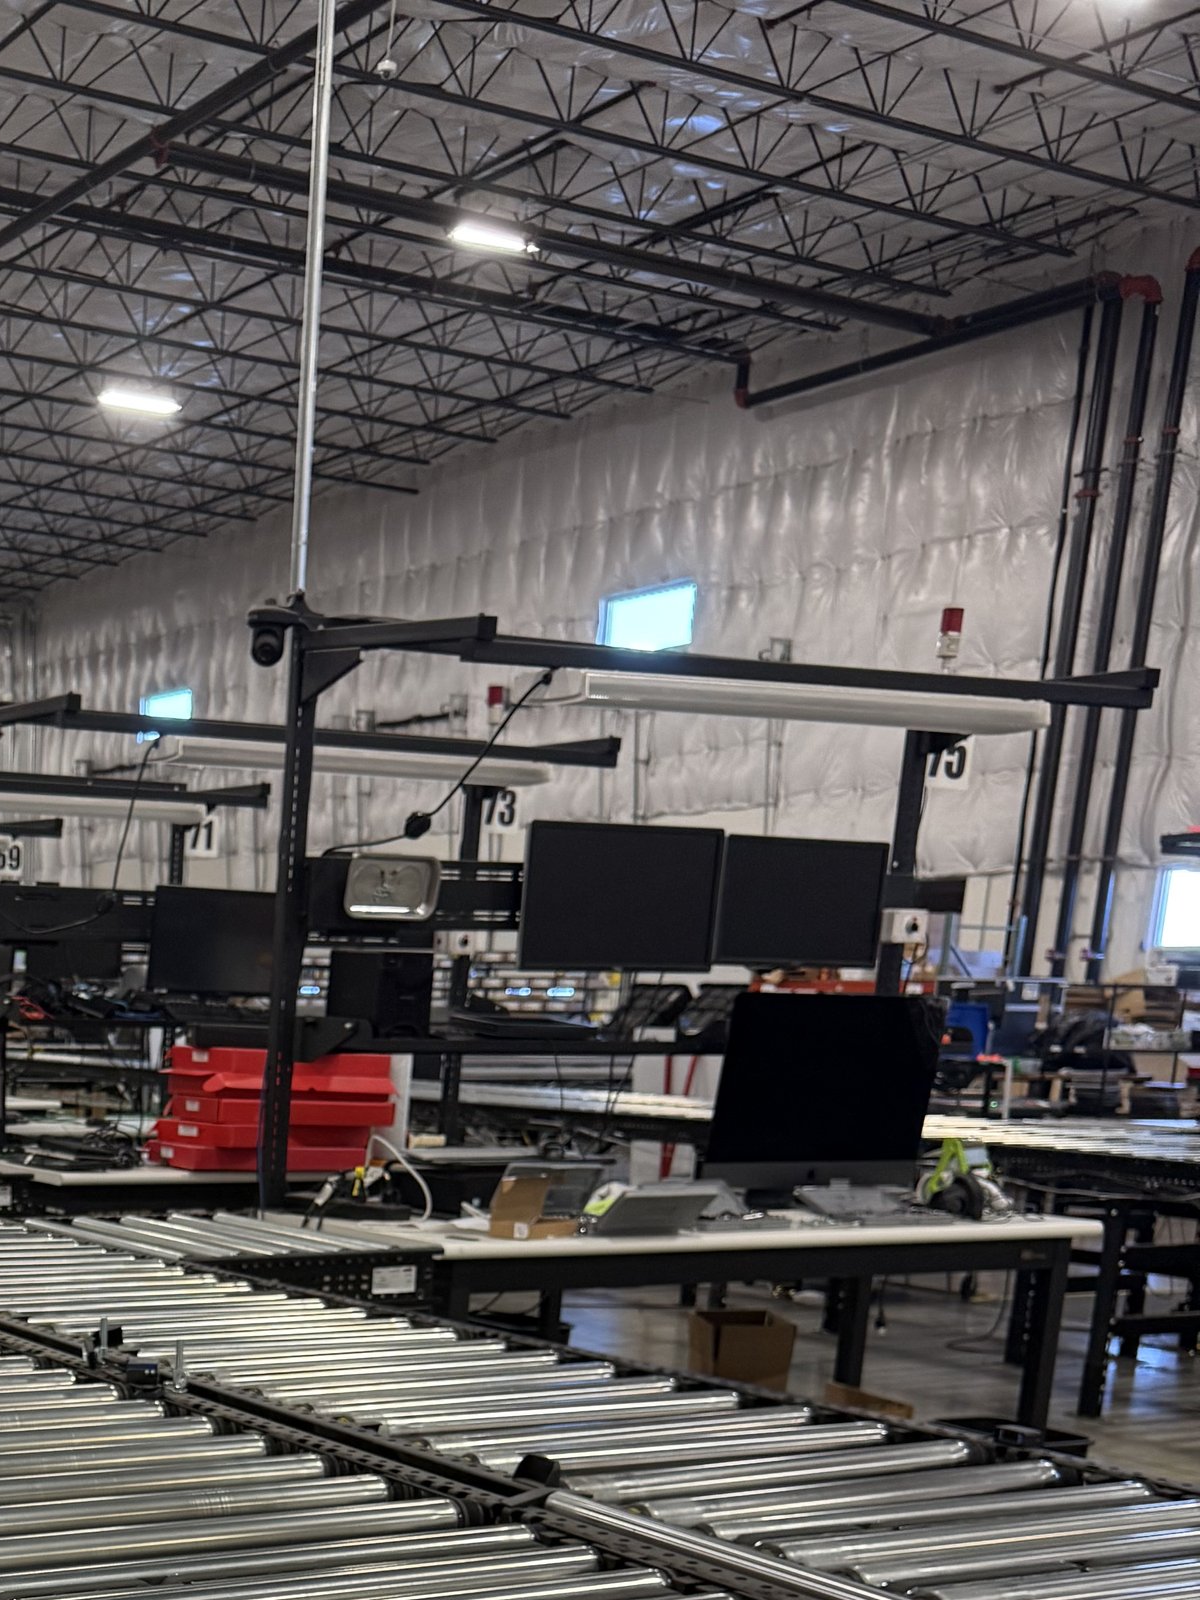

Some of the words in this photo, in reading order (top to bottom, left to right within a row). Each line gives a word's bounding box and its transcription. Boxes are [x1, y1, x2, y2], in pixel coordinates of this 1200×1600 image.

[927, 745, 967, 779] 75
[485, 790, 516, 826] 73
[191, 820, 213, 850] 71
